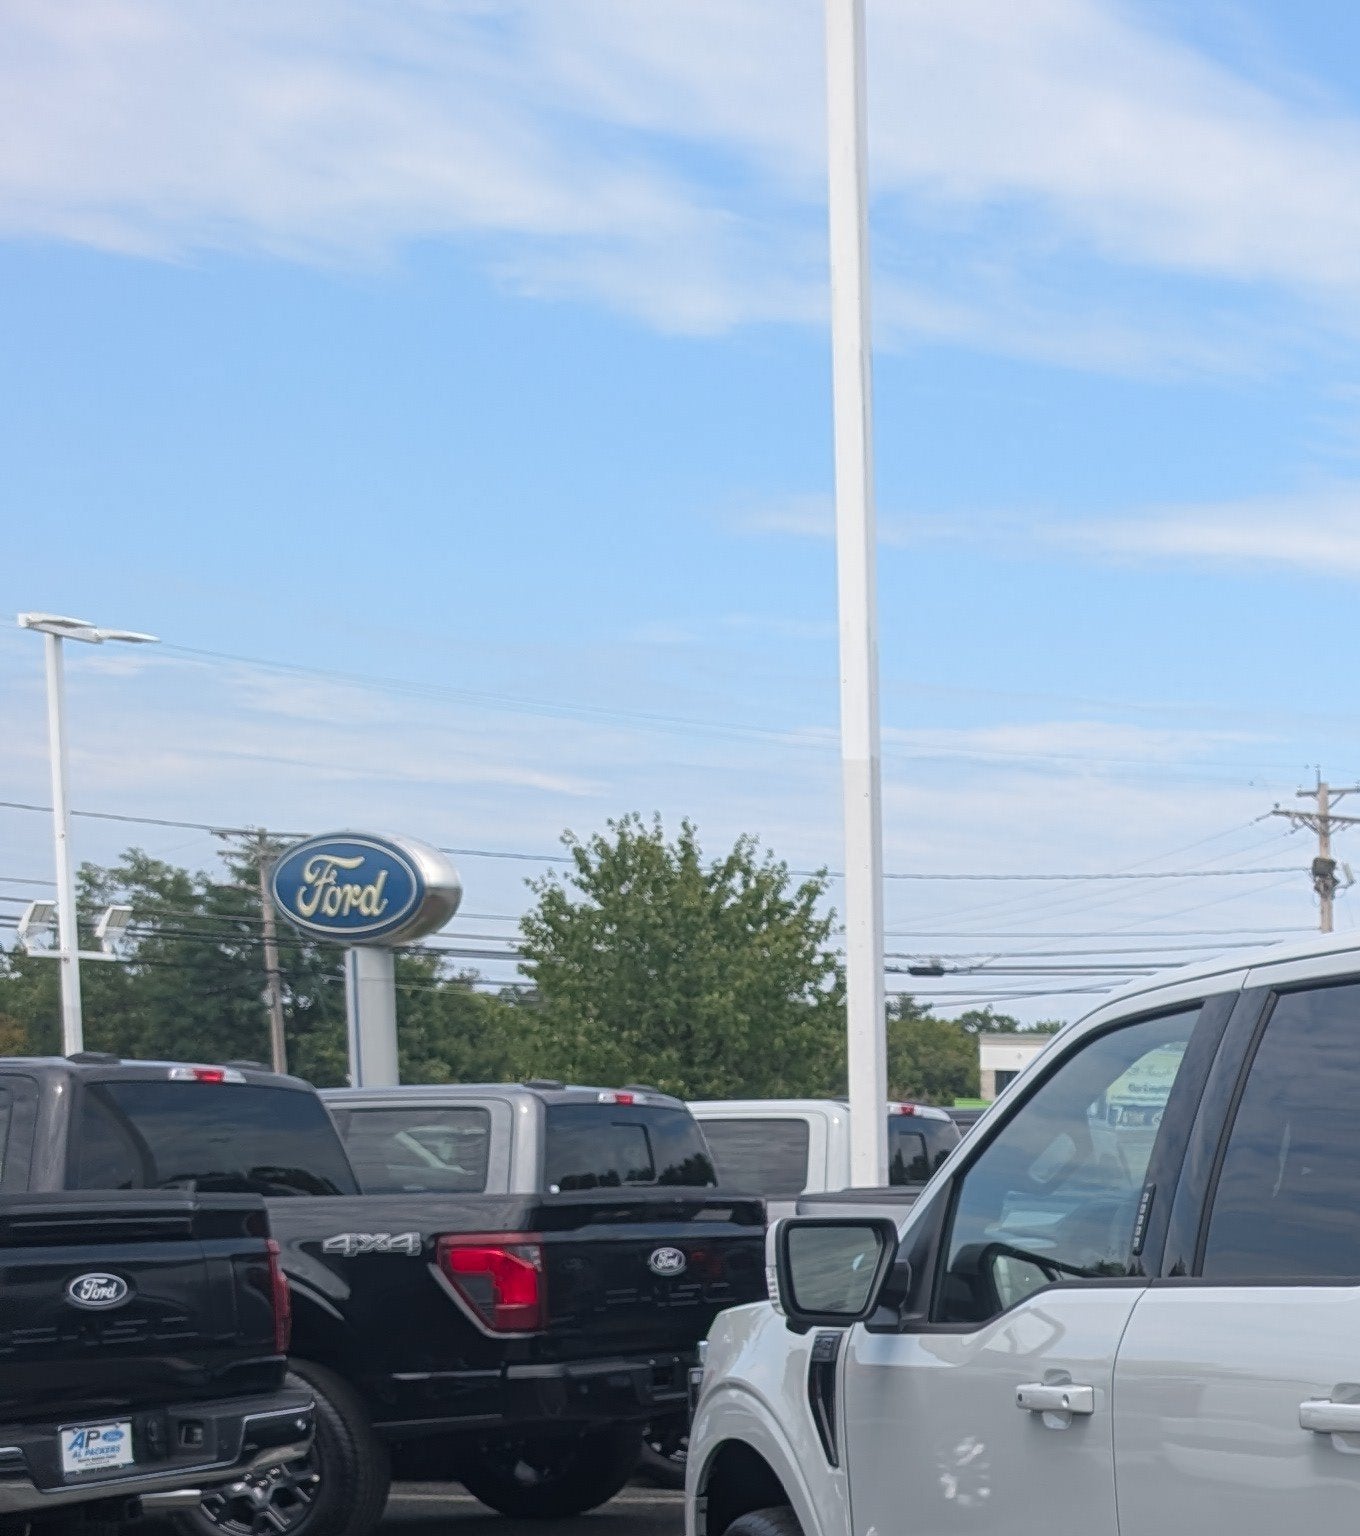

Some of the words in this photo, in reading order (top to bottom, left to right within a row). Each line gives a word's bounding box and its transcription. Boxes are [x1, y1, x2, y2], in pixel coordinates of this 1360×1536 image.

[296, 854, 389, 918] Ford
[80, 1278, 118, 1301] Ford
[68, 1429, 101, 1451] AP
